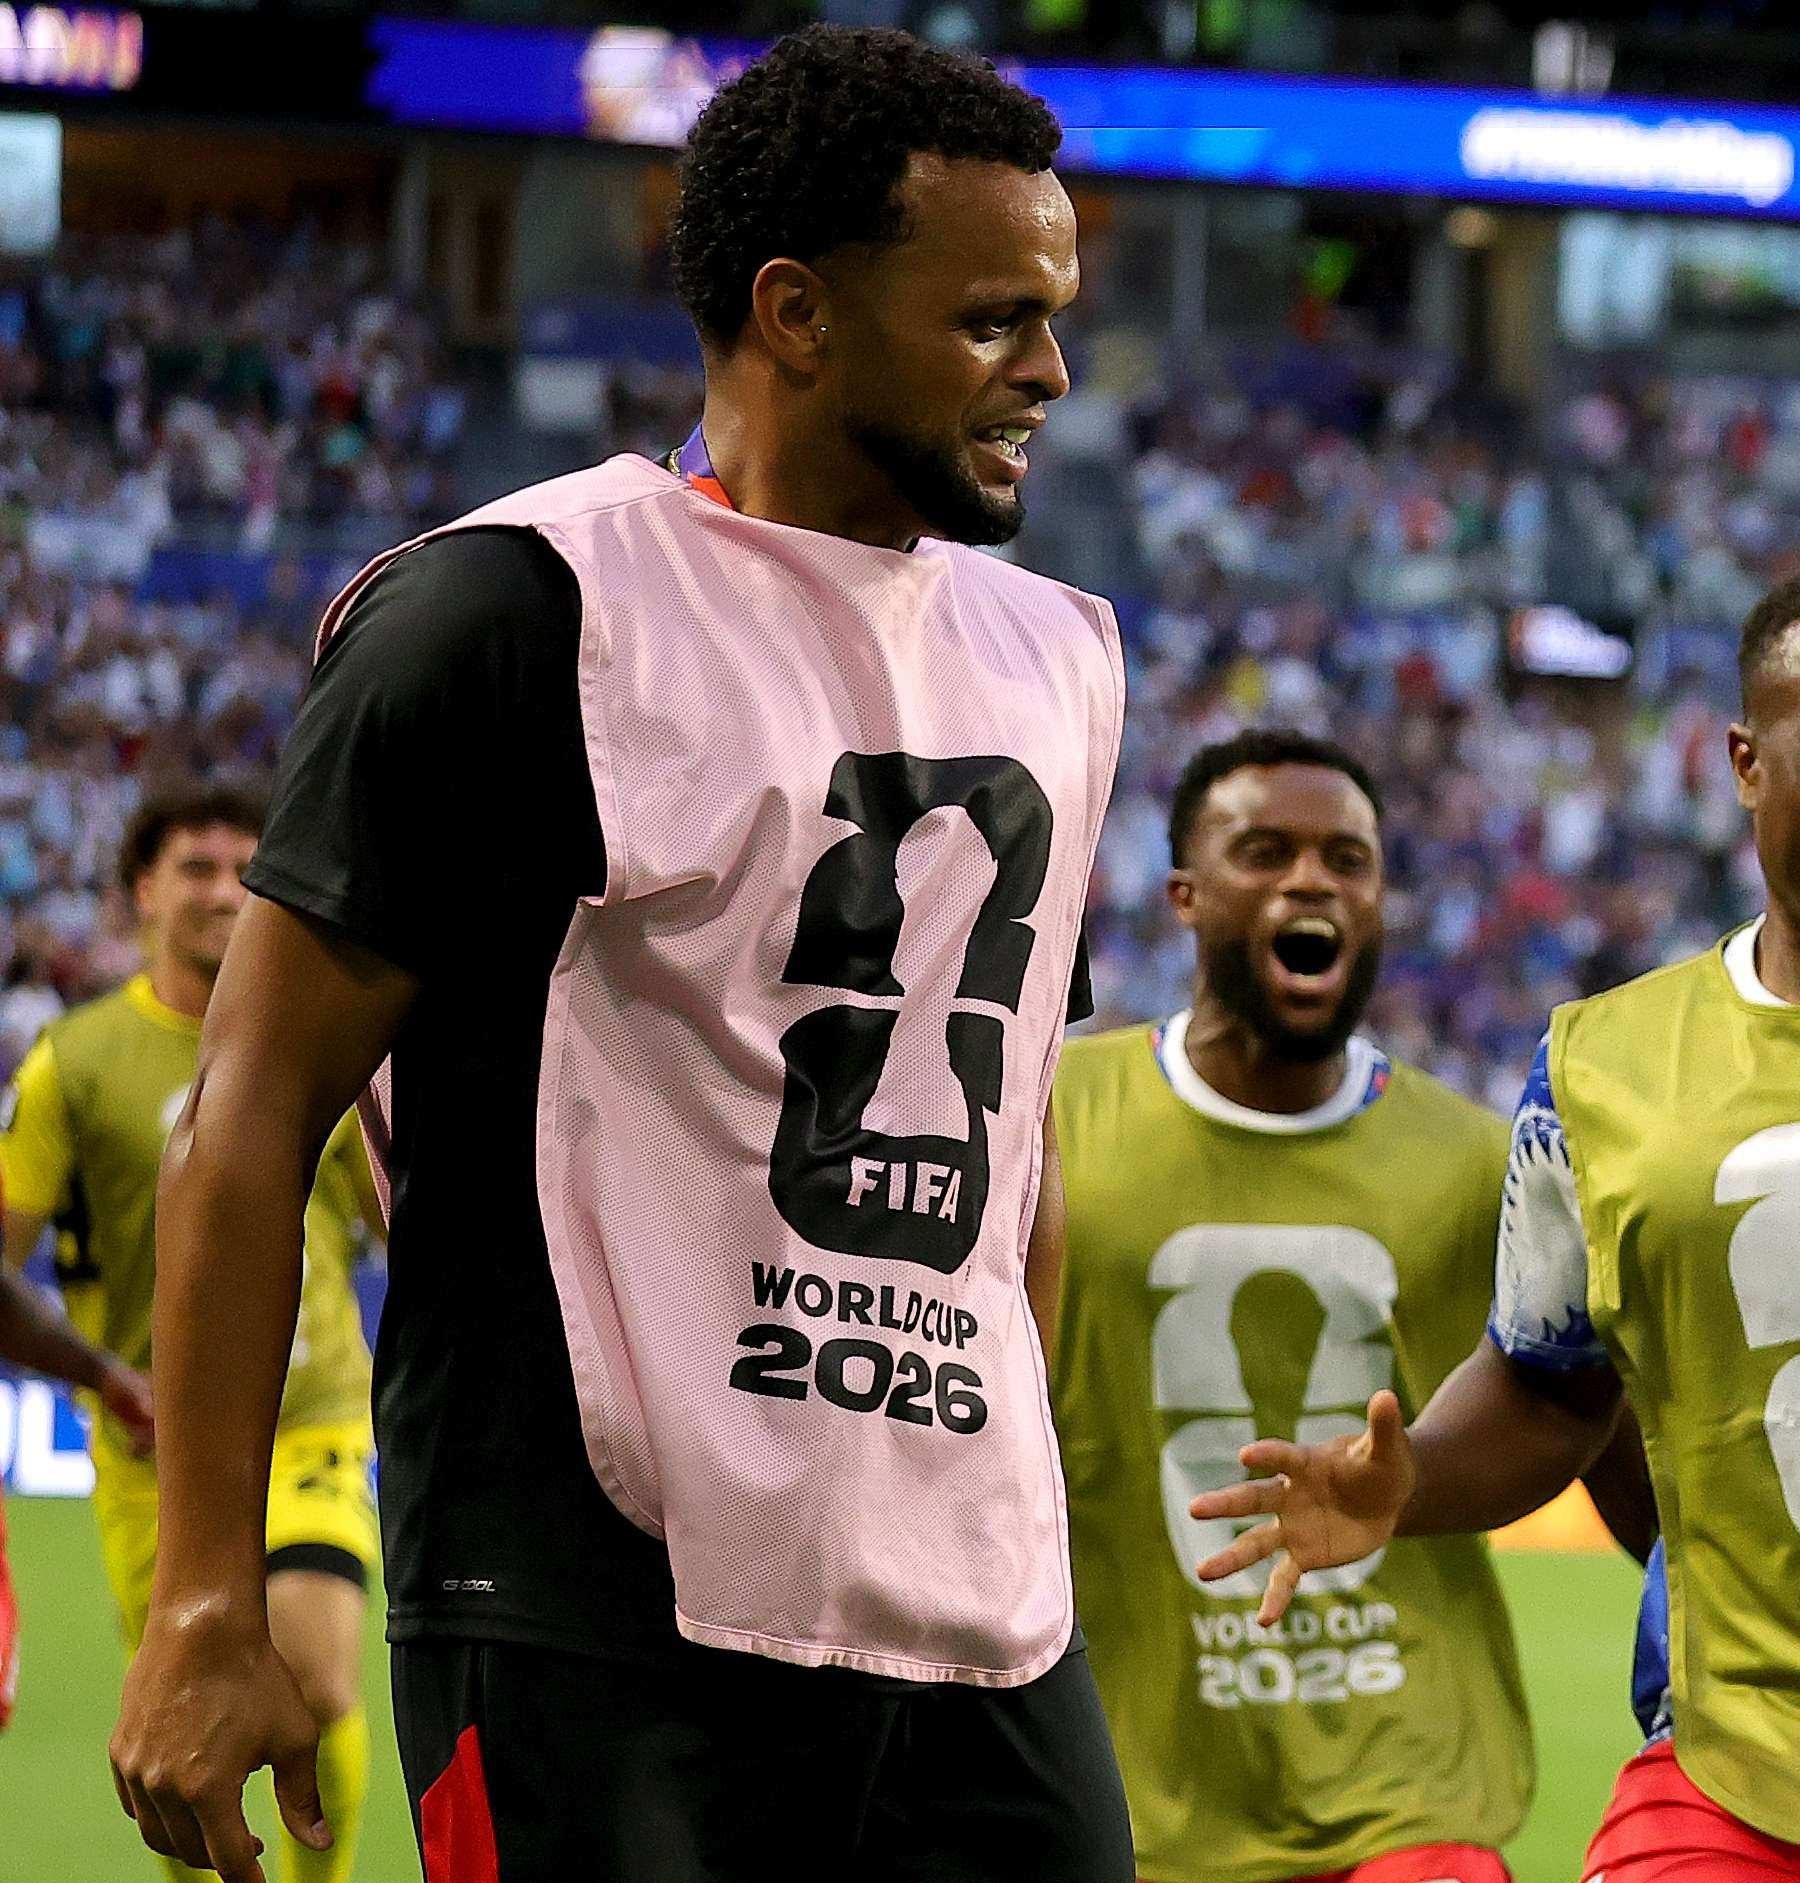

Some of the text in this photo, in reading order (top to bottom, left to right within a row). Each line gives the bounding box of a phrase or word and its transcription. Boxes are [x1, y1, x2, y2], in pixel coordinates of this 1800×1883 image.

[847, 1156, 962, 1224] FIFA
[729, 1323, 988, 1434] 2026
[1197, 1640, 1408, 1709] 2026
